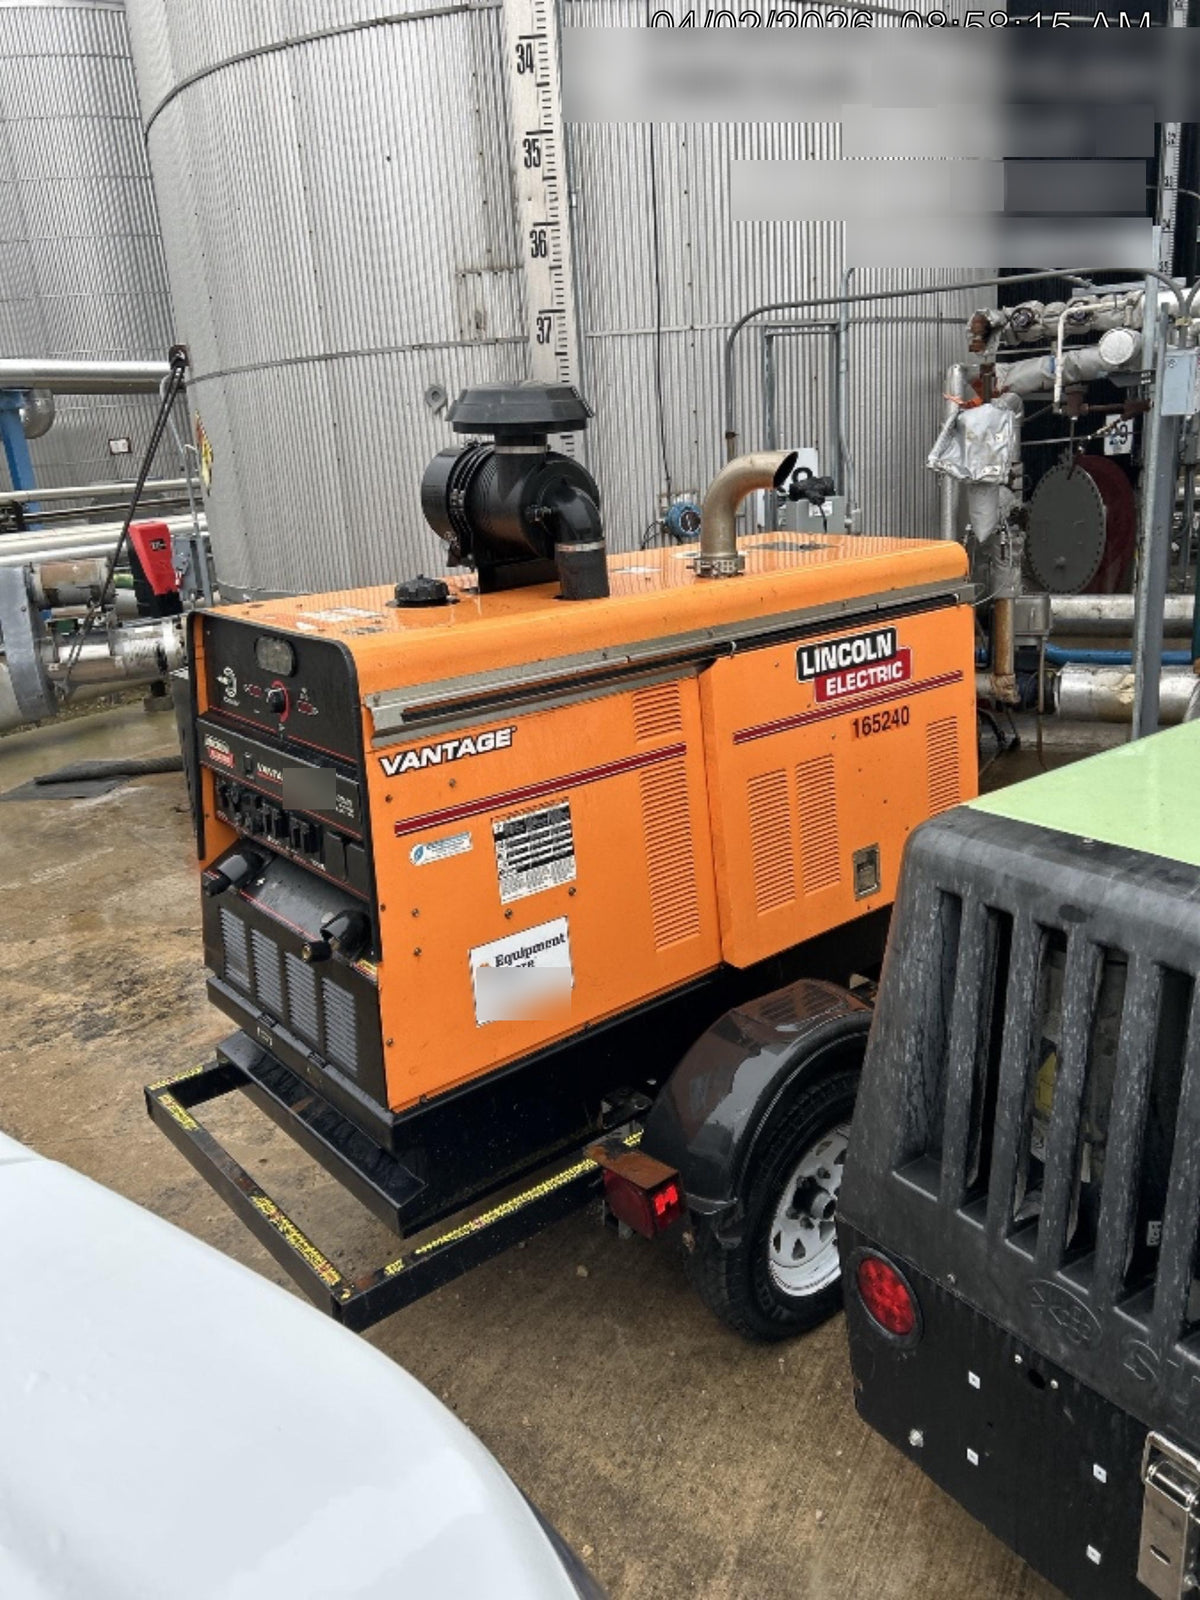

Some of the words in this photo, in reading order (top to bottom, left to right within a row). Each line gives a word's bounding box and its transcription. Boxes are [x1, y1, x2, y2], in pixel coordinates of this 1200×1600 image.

[515, 42, 534, 75] 34
[523, 138, 541, 168] 35
[530, 229, 547, 258] 36
[536, 317, 552, 344] 37
[801, 632, 893, 677] LINCOLN
[825, 660, 904, 697] ELECTRIC
[852, 705, 911, 739] 165240
[379, 727, 514, 776] VANTAGE
[494, 932, 567, 968] Equipment
